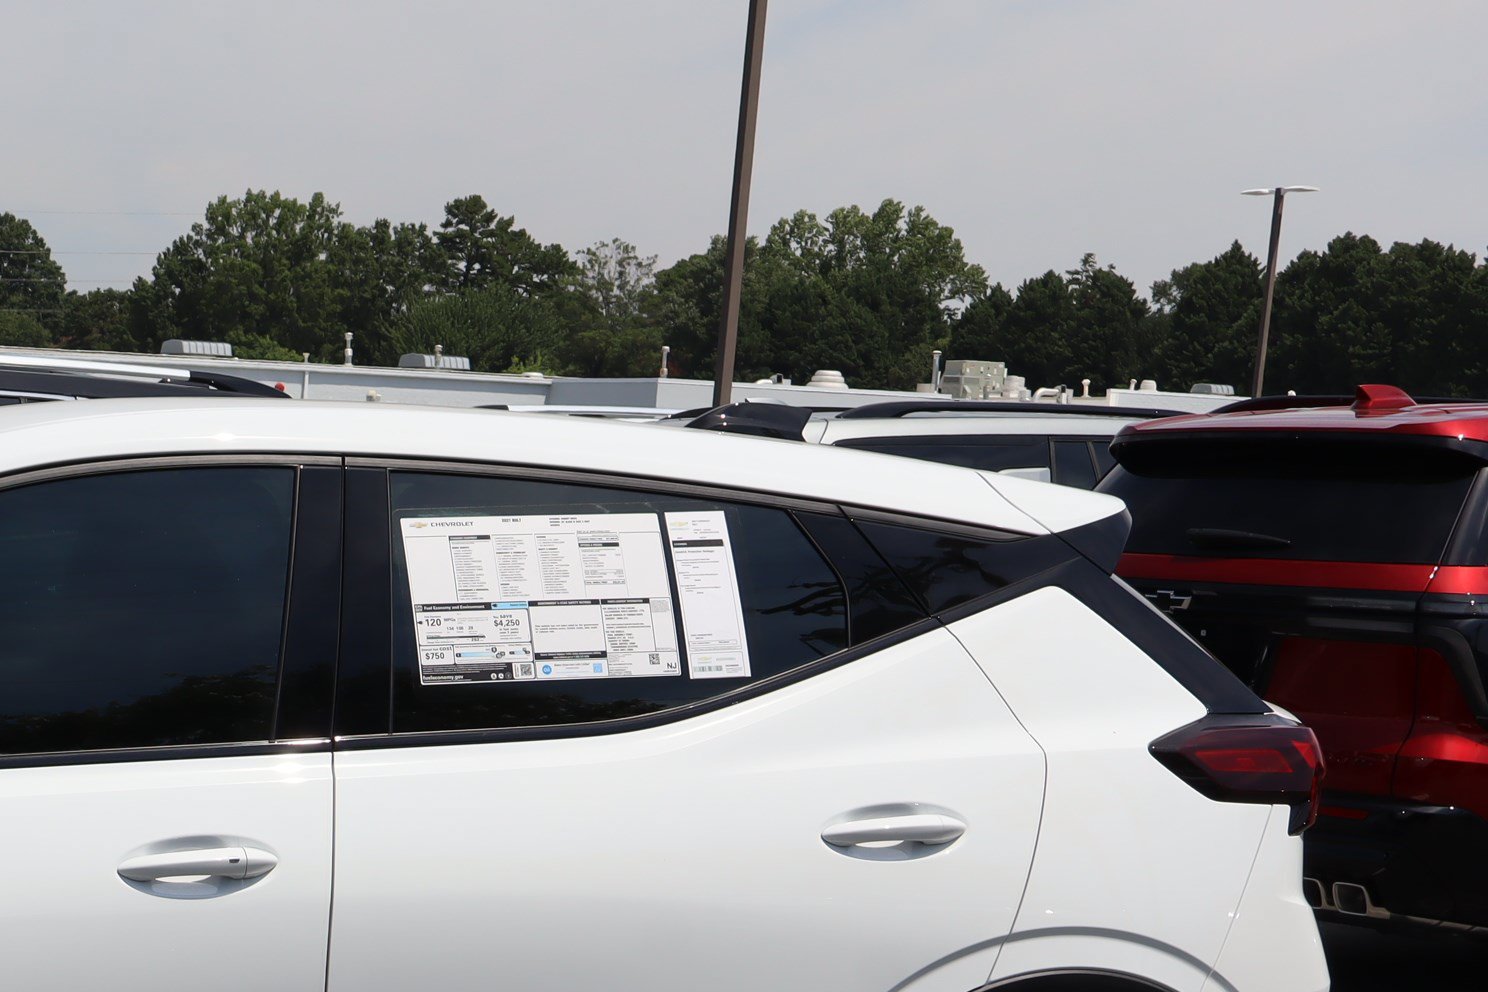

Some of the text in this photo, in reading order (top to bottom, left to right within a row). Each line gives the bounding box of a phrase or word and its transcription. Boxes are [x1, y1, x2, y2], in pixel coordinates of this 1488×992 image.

[425, 618, 442, 627] 120
[493, 619, 520, 627] $4,250
[425, 652, 445, 660] $750
